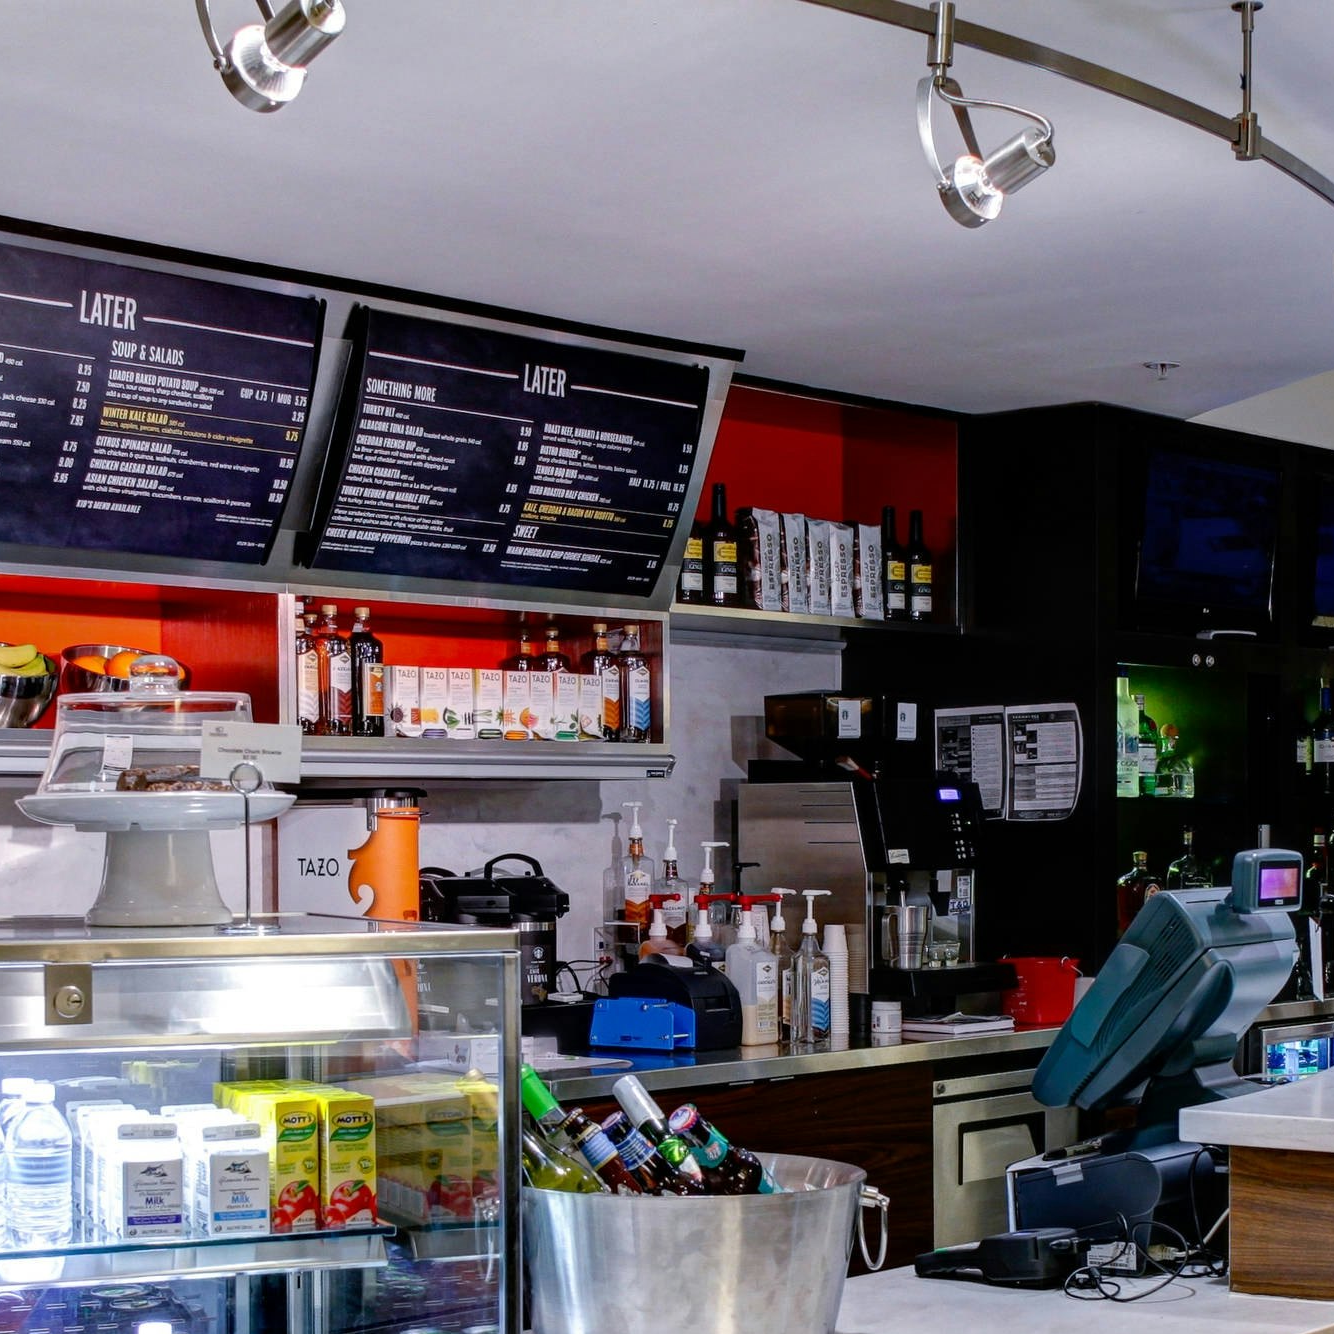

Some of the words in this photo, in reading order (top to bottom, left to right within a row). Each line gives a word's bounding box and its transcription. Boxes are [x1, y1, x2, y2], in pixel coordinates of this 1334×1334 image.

[79, 290, 137, 331] LATER
[111, 340, 138, 359] SOUP
[139, 344, 147, 361] &
[148, 345, 185, 366] SALADS
[76, 380, 91, 393] 7.50
[523, 363, 567, 399] LATER
[365, 377, 413, 399] SOMETHING
[413, 385, 437, 403] MORE
[102, 406, 129, 420] WINTER
[128, 410, 147, 423] KALE
[146, 412, 169, 425] SALAD
[512, 524, 540, 539] SWEET
[839, 544, 847, 598] ESPRESSO
[868, 545, 876, 598] ESPRESSO
[398, 669, 417, 679] TAZO
[425, 671, 445, 680] TAZO
[451, 671, 471, 680] TAZO
[481, 672, 500, 682] TAZO
[509, 675, 528, 684] TAZO
[532, 674, 551, 684] TAZO
[559, 675, 577, 685] TAZO
[583, 677, 601, 687] TAZO
[298, 858, 339, 876] TAZO
[145, 1196, 164, 1205] Milk
[231, 1195, 251, 1204] Milk
